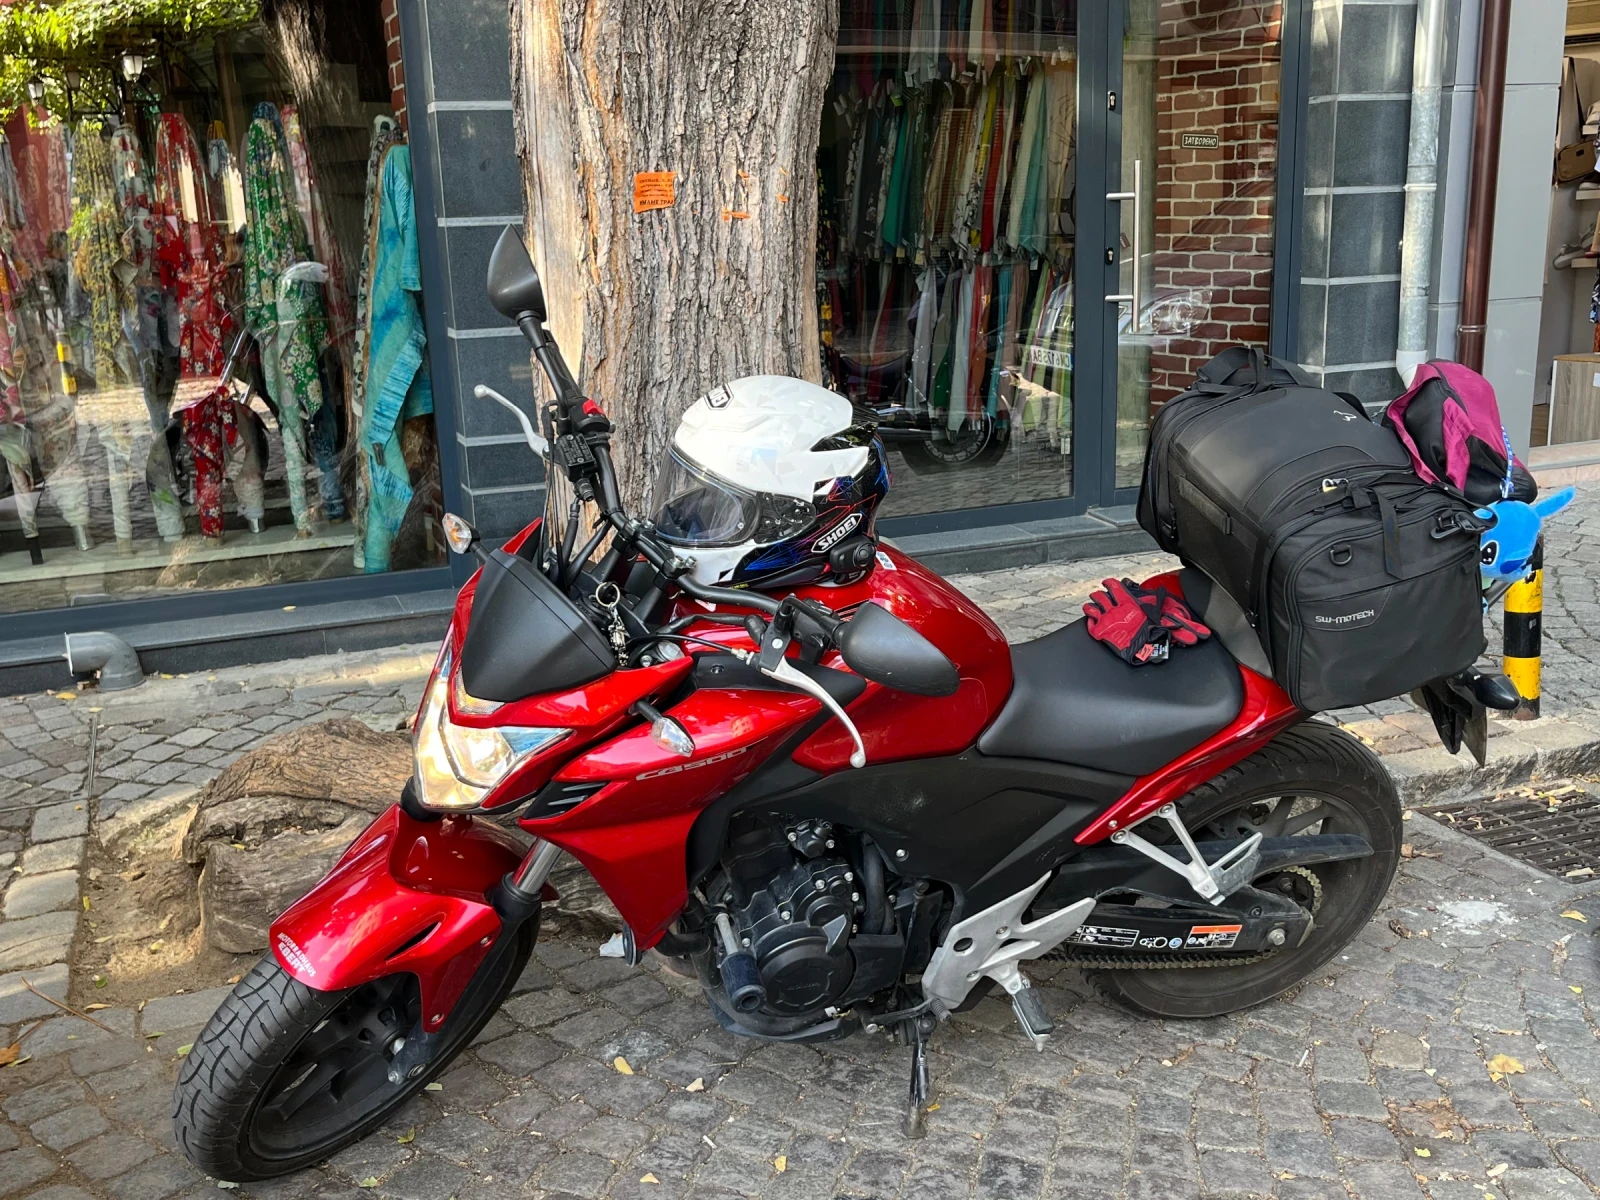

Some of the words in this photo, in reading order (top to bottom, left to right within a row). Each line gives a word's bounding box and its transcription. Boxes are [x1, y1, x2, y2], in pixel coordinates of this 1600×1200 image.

[817, 516, 857, 551] SHOEI
[1314, 608, 1375, 624] SW-MOTECH
[276, 932, 317, 978] MOTORRADHAUS
[277, 941, 306, 973] EBERT
